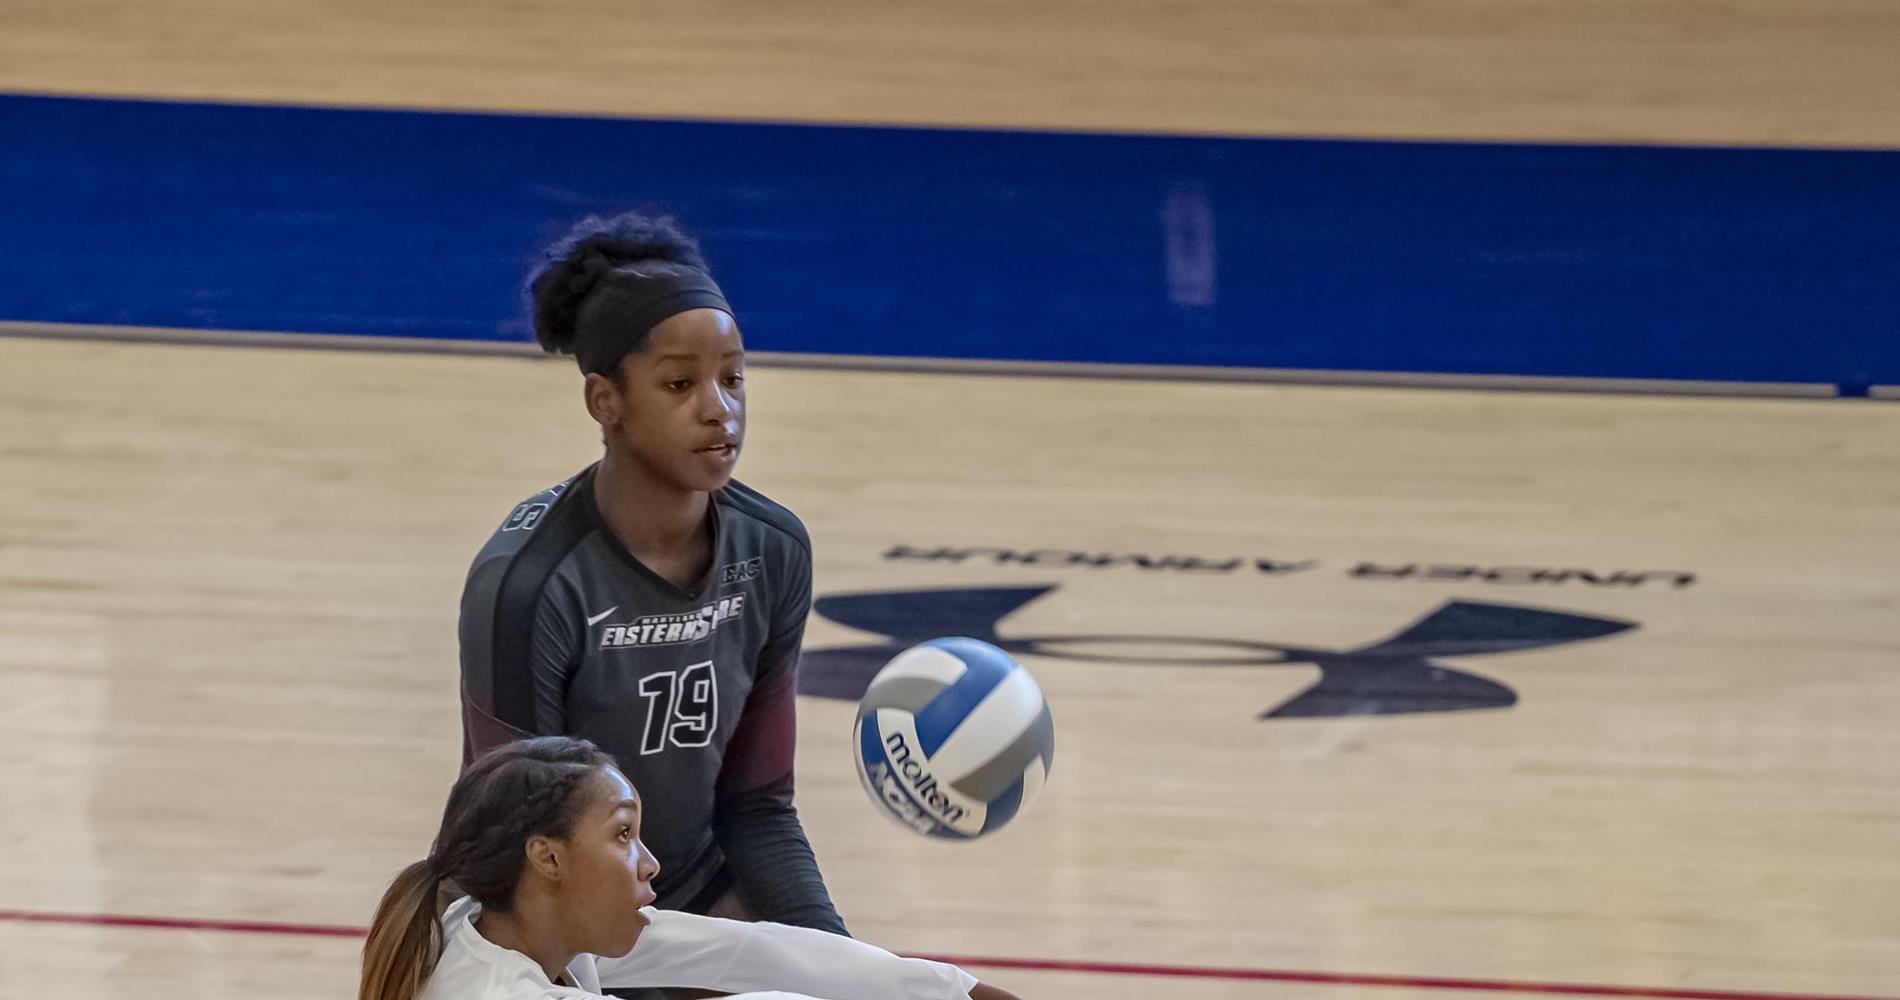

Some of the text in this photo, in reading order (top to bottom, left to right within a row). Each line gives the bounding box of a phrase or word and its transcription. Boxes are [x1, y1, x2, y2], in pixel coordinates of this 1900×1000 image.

[882, 544, 1697, 589] UNDER ARMOUR
[639, 660, 718, 755] 19
[886, 732, 964, 824] molten
